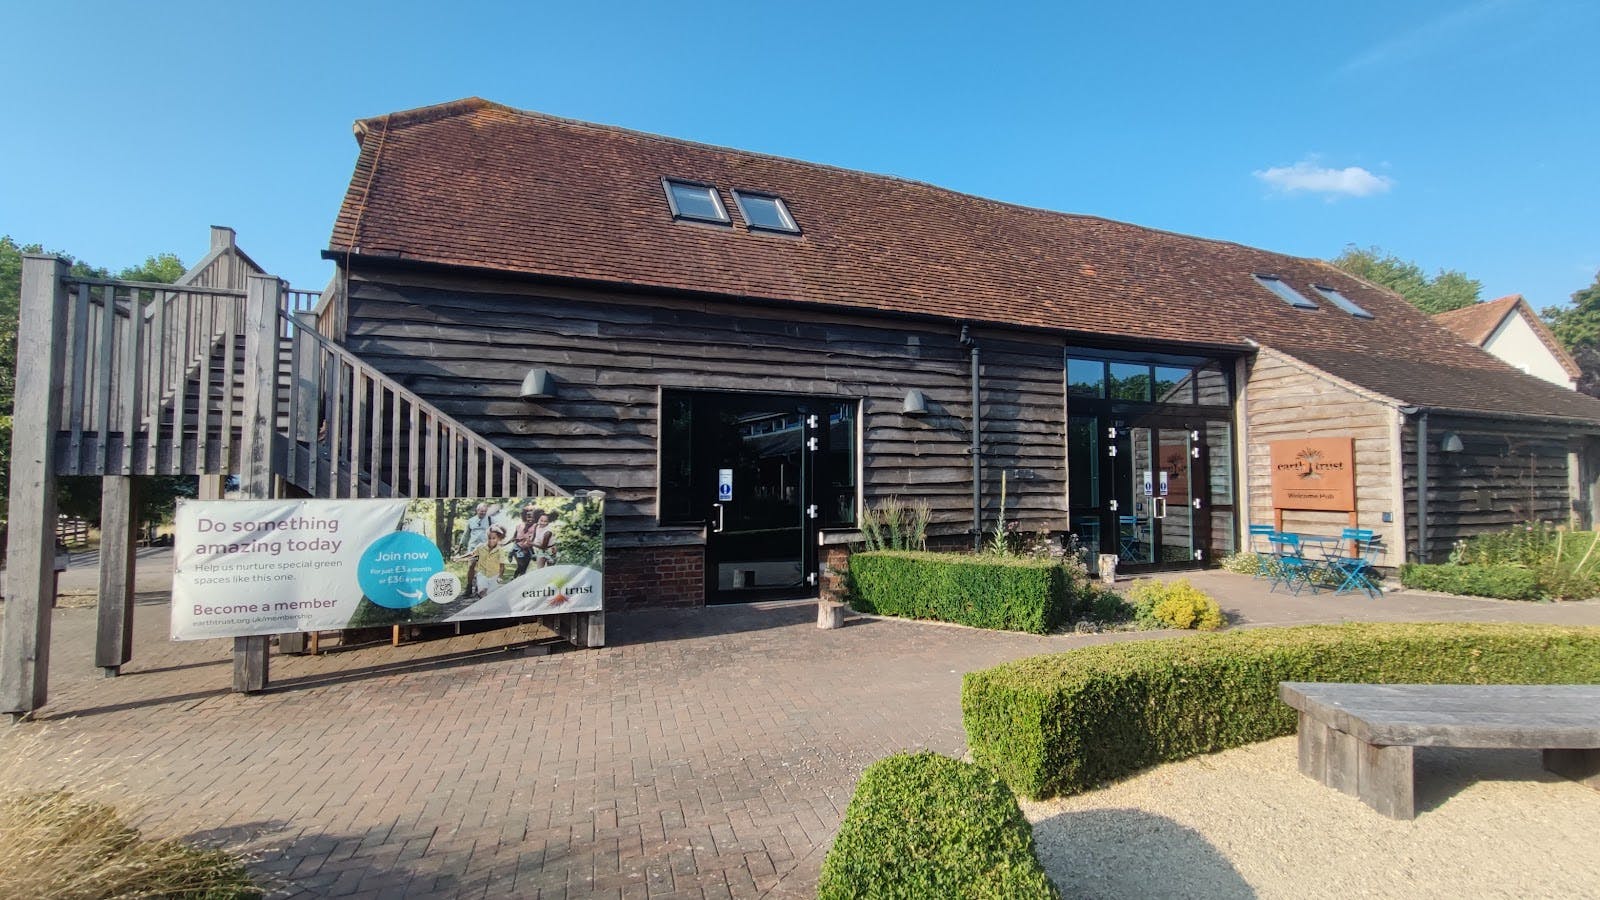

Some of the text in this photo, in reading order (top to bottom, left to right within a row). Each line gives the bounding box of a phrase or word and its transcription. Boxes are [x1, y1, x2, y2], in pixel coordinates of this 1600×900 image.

[1315, 461, 1343, 470] trust
[197, 516, 339, 533] Do something
[195, 537, 342, 556] amazing today
[375, 551, 429, 562] Join now
[194, 560, 343, 574] Help us nurture special green
[194, 573, 297, 586] spaces like this one.
[522, 585, 593, 598] earth trust
[193, 598, 338, 616] Become a member
